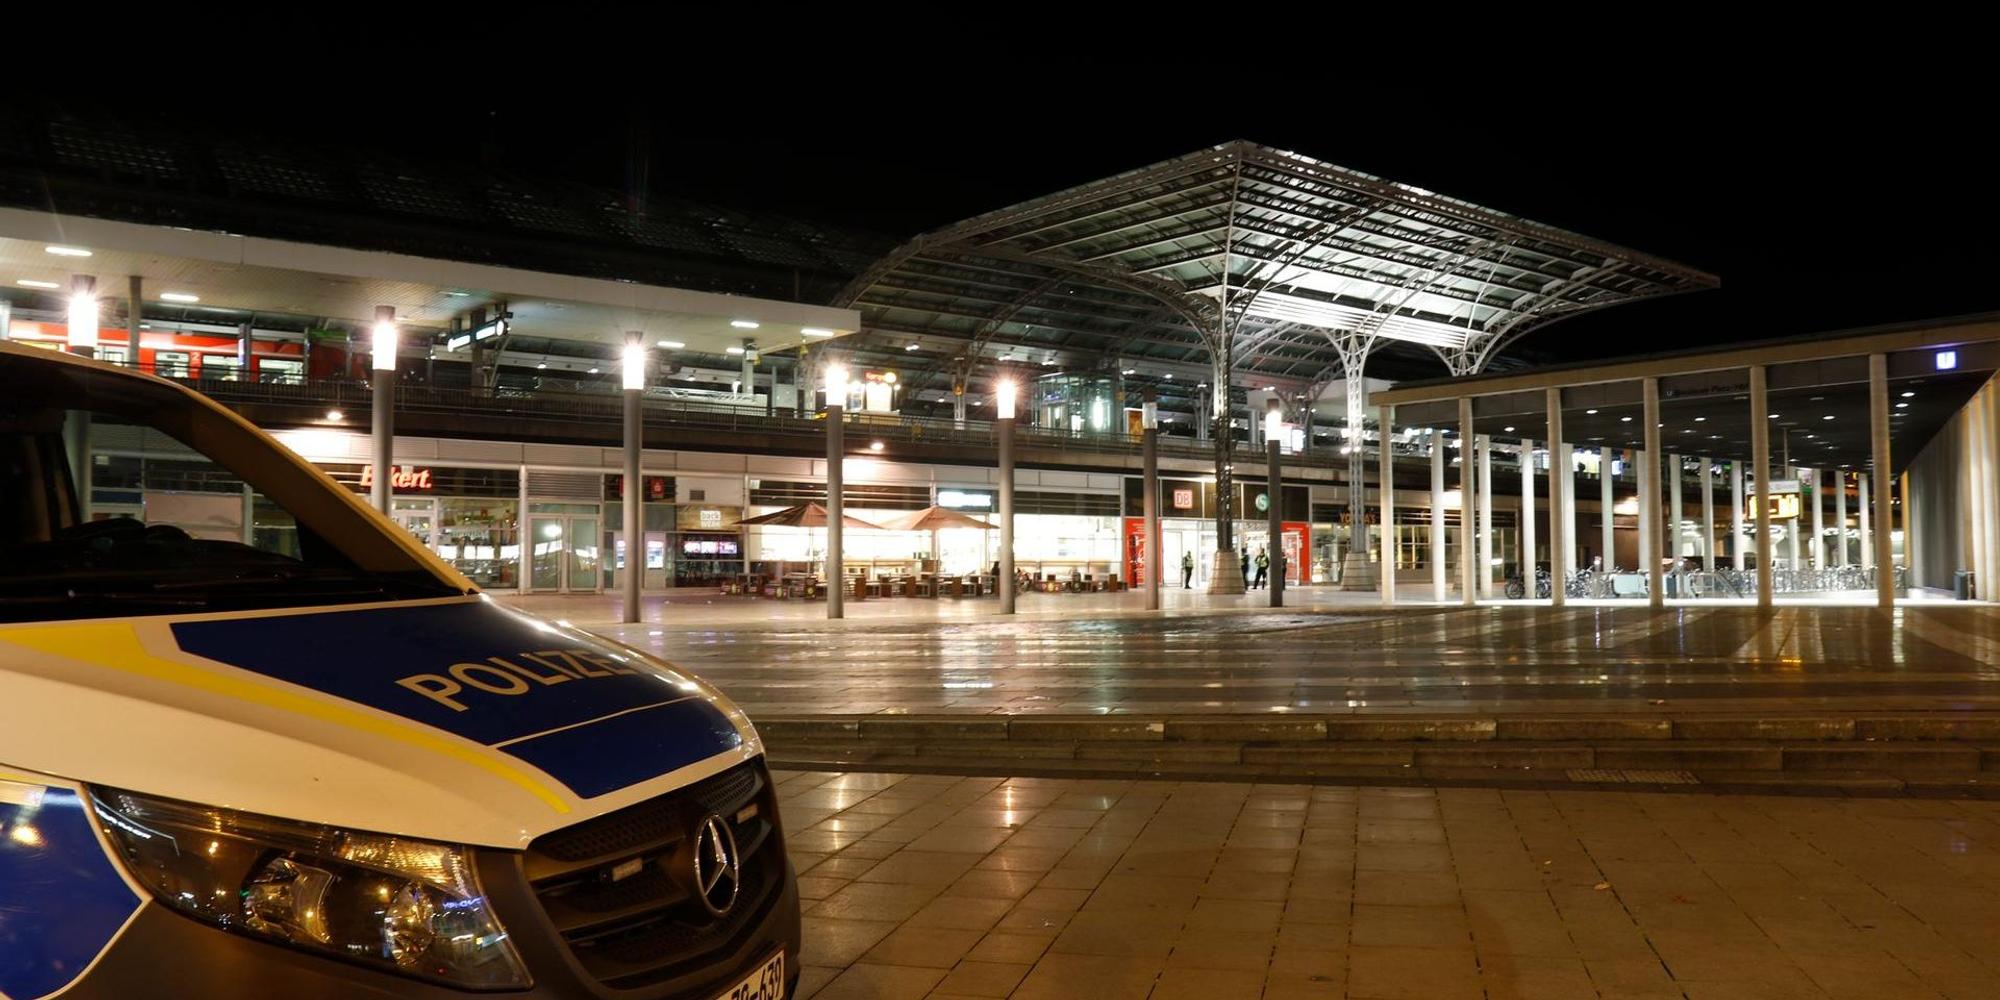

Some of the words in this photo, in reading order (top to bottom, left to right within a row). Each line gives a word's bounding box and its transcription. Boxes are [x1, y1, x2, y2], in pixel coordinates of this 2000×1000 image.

[360, 465, 432, 488] Ekert.
[1176, 492, 1191, 506] DB
[1257, 494, 1267, 510] S
[394, 649, 639, 712] POLIZE
